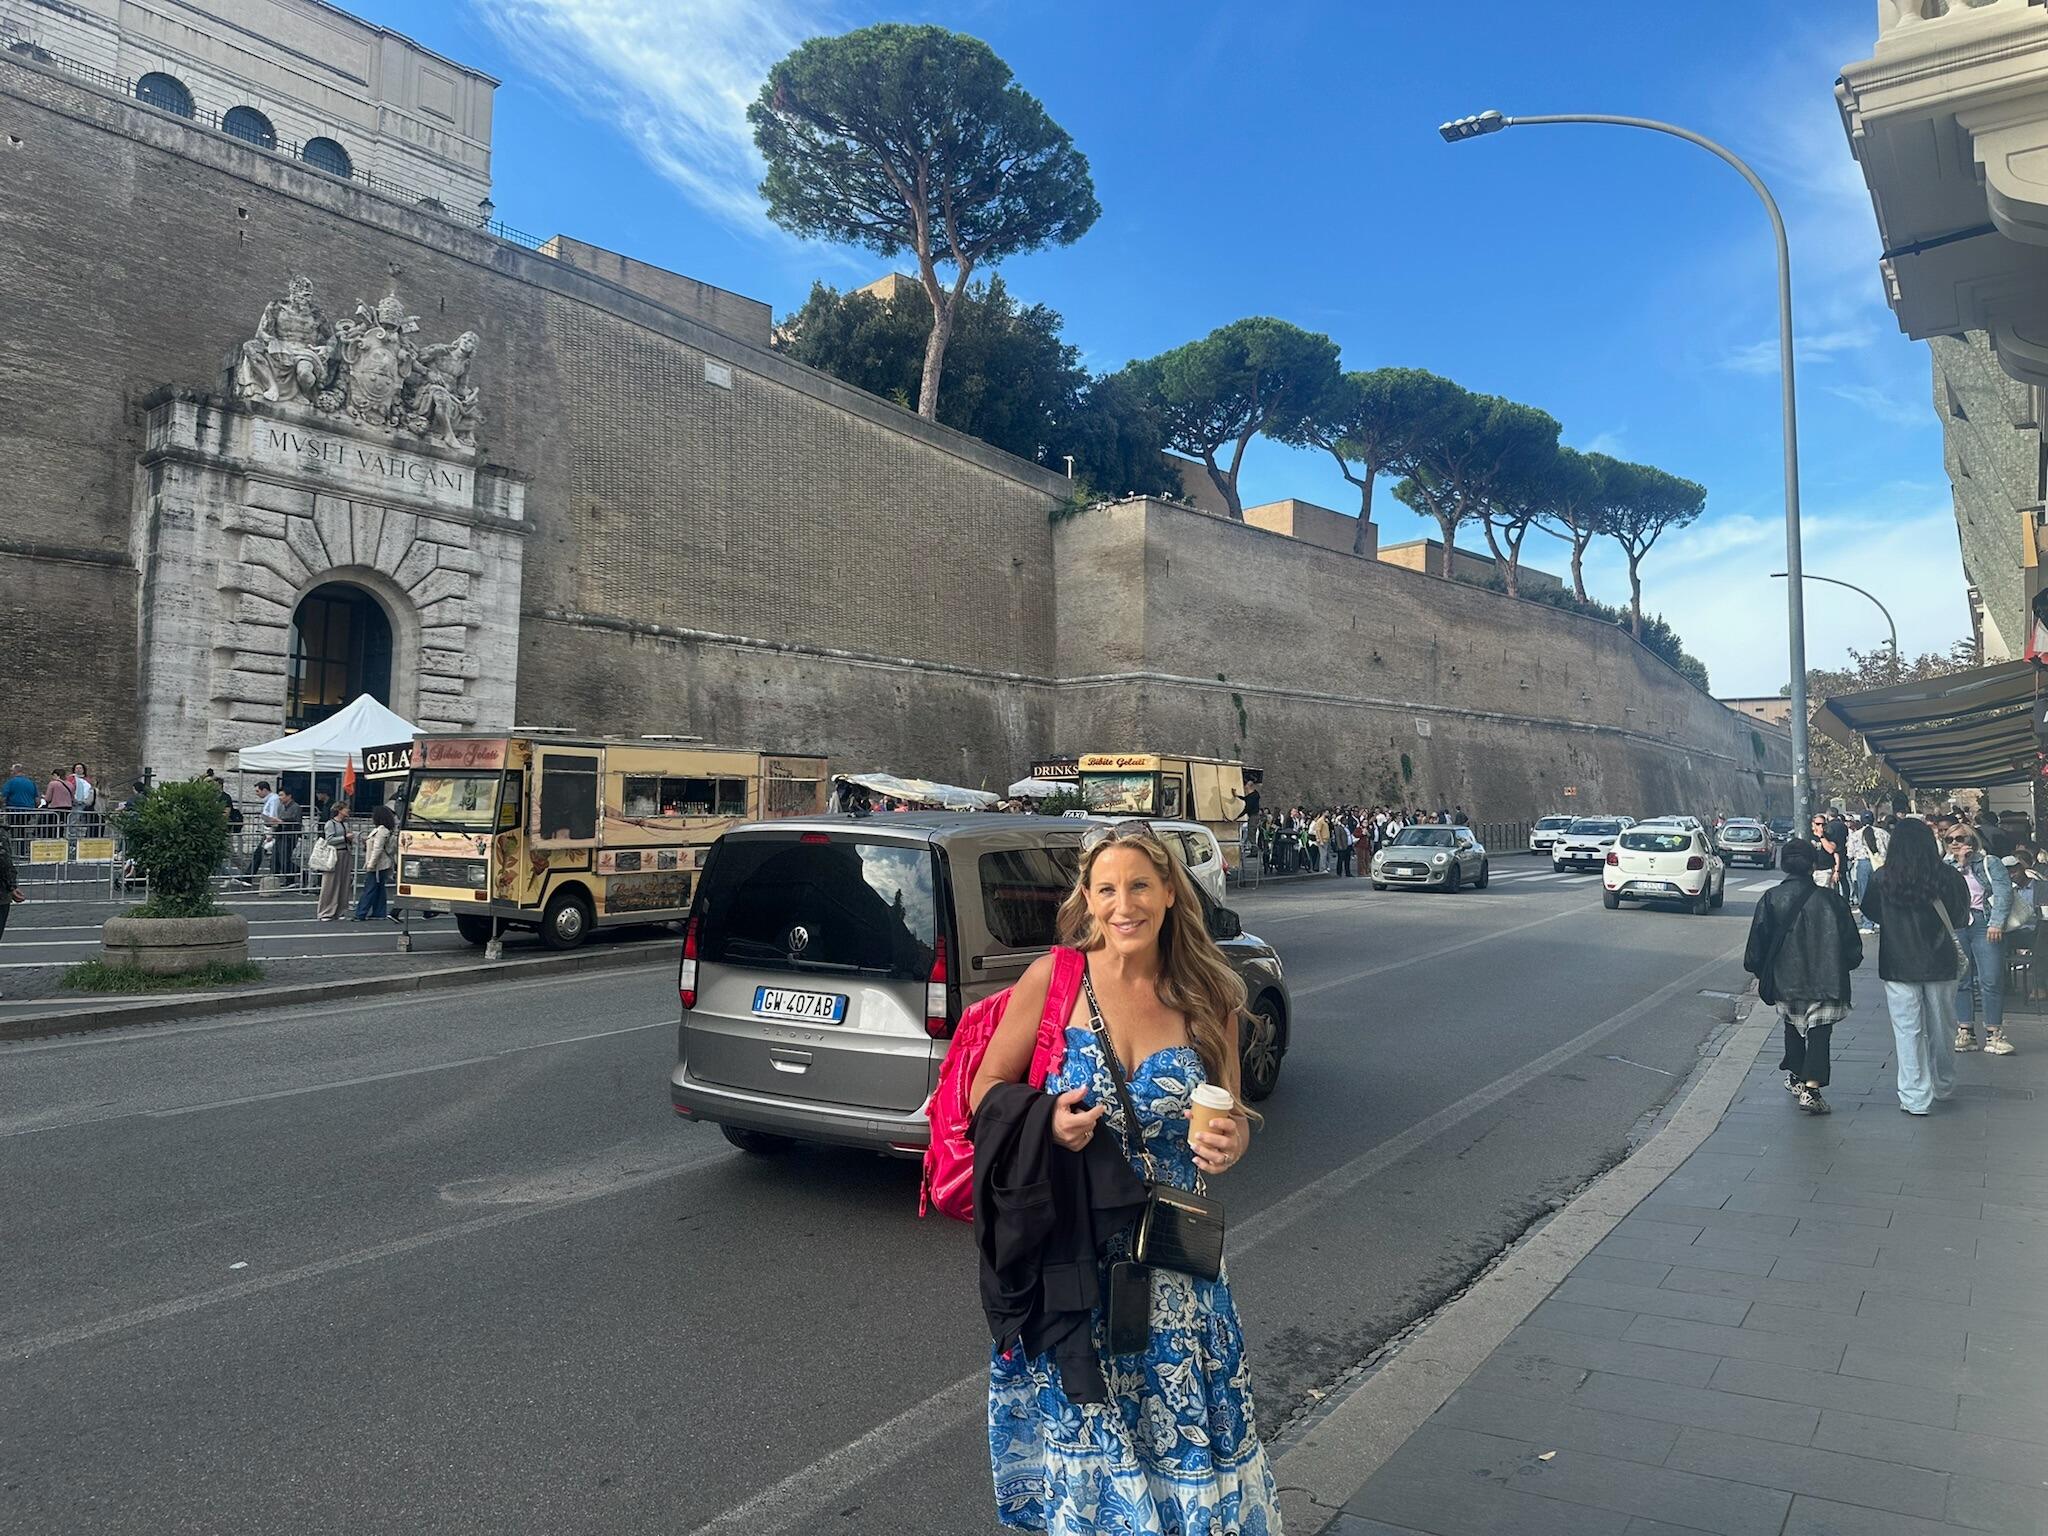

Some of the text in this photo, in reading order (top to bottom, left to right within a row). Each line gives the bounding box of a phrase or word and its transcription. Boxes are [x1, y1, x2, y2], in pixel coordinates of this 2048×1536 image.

[269, 429, 463, 491] MVSEI VATICANI
[366, 749, 412, 772] GELA
[1033, 764, 1079, 776] DRINKS
[786, 994, 833, 1016] 407AB
